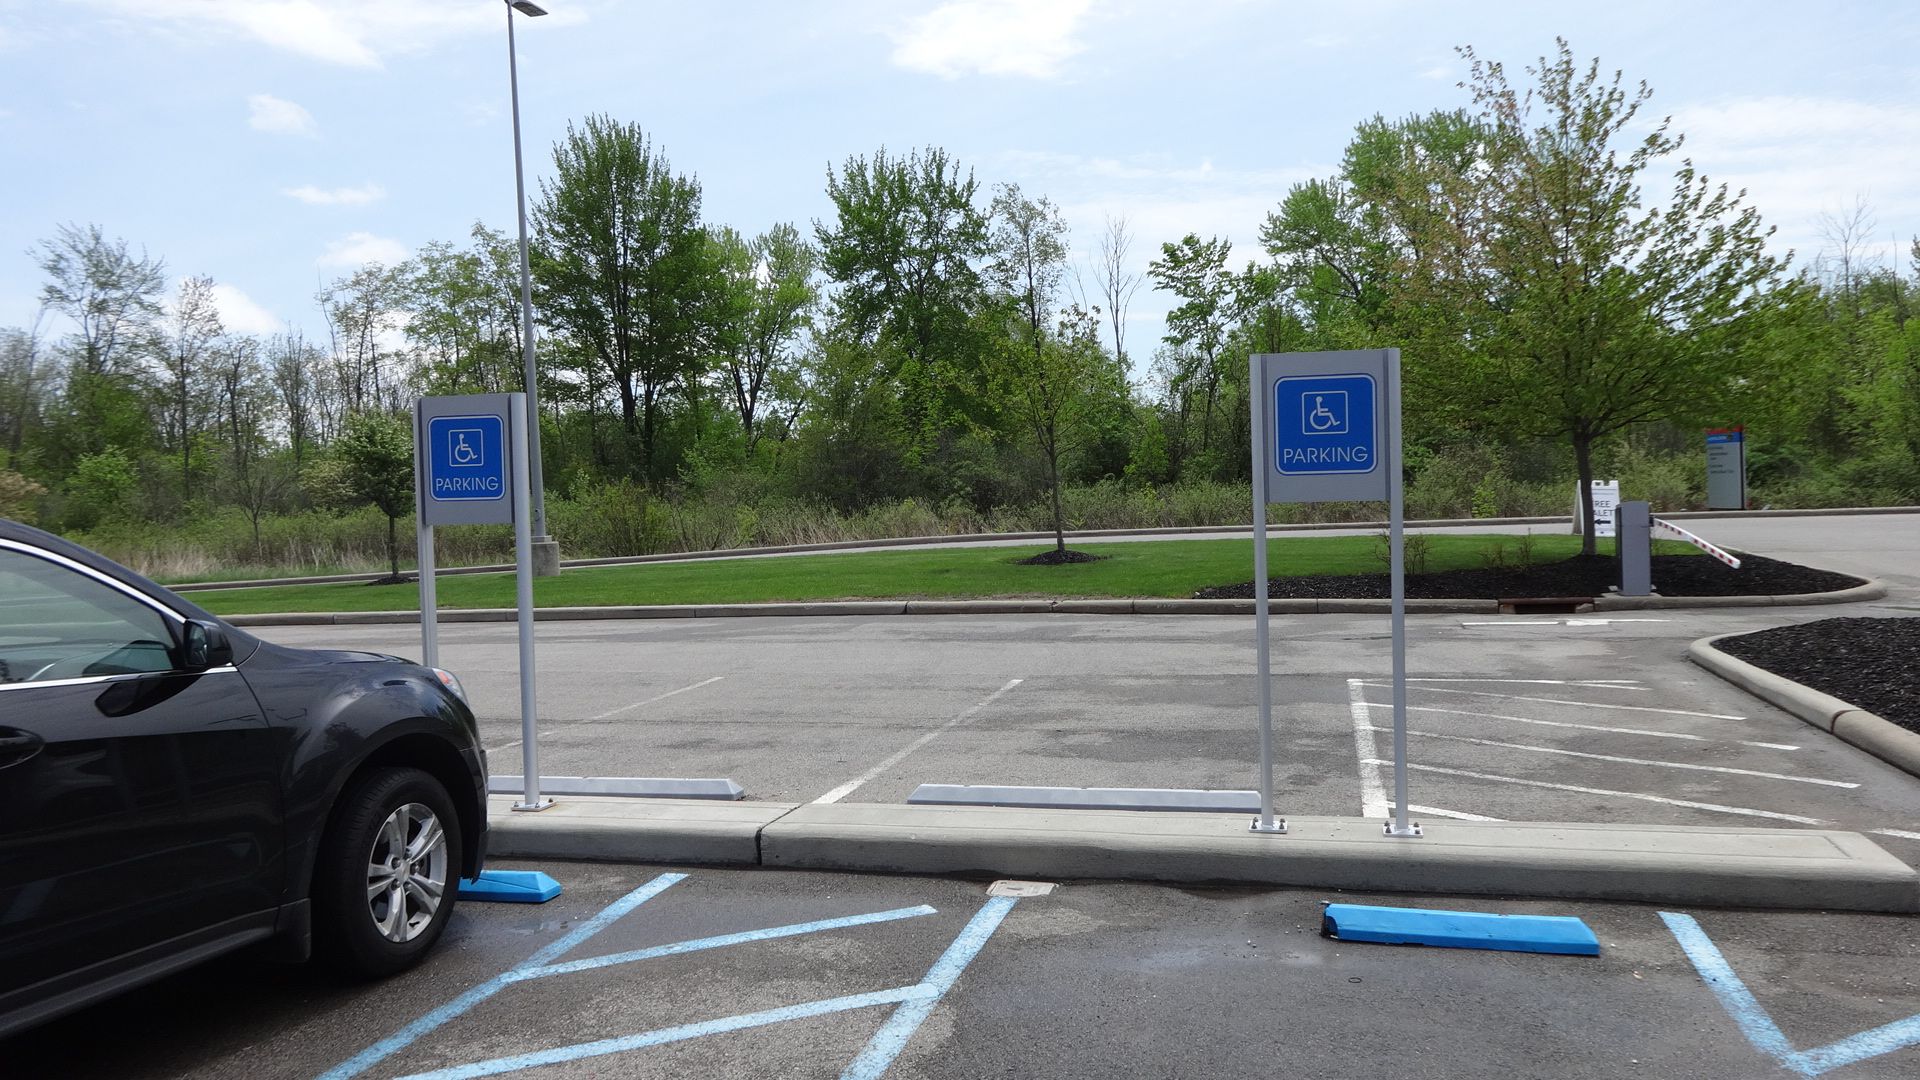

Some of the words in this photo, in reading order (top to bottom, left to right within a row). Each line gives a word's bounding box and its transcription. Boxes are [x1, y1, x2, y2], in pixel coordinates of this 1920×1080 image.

[1283, 446, 1369, 464] PARKING
[435, 476, 499, 492] PARKING
[1593, 509, 1614, 517] ALET
